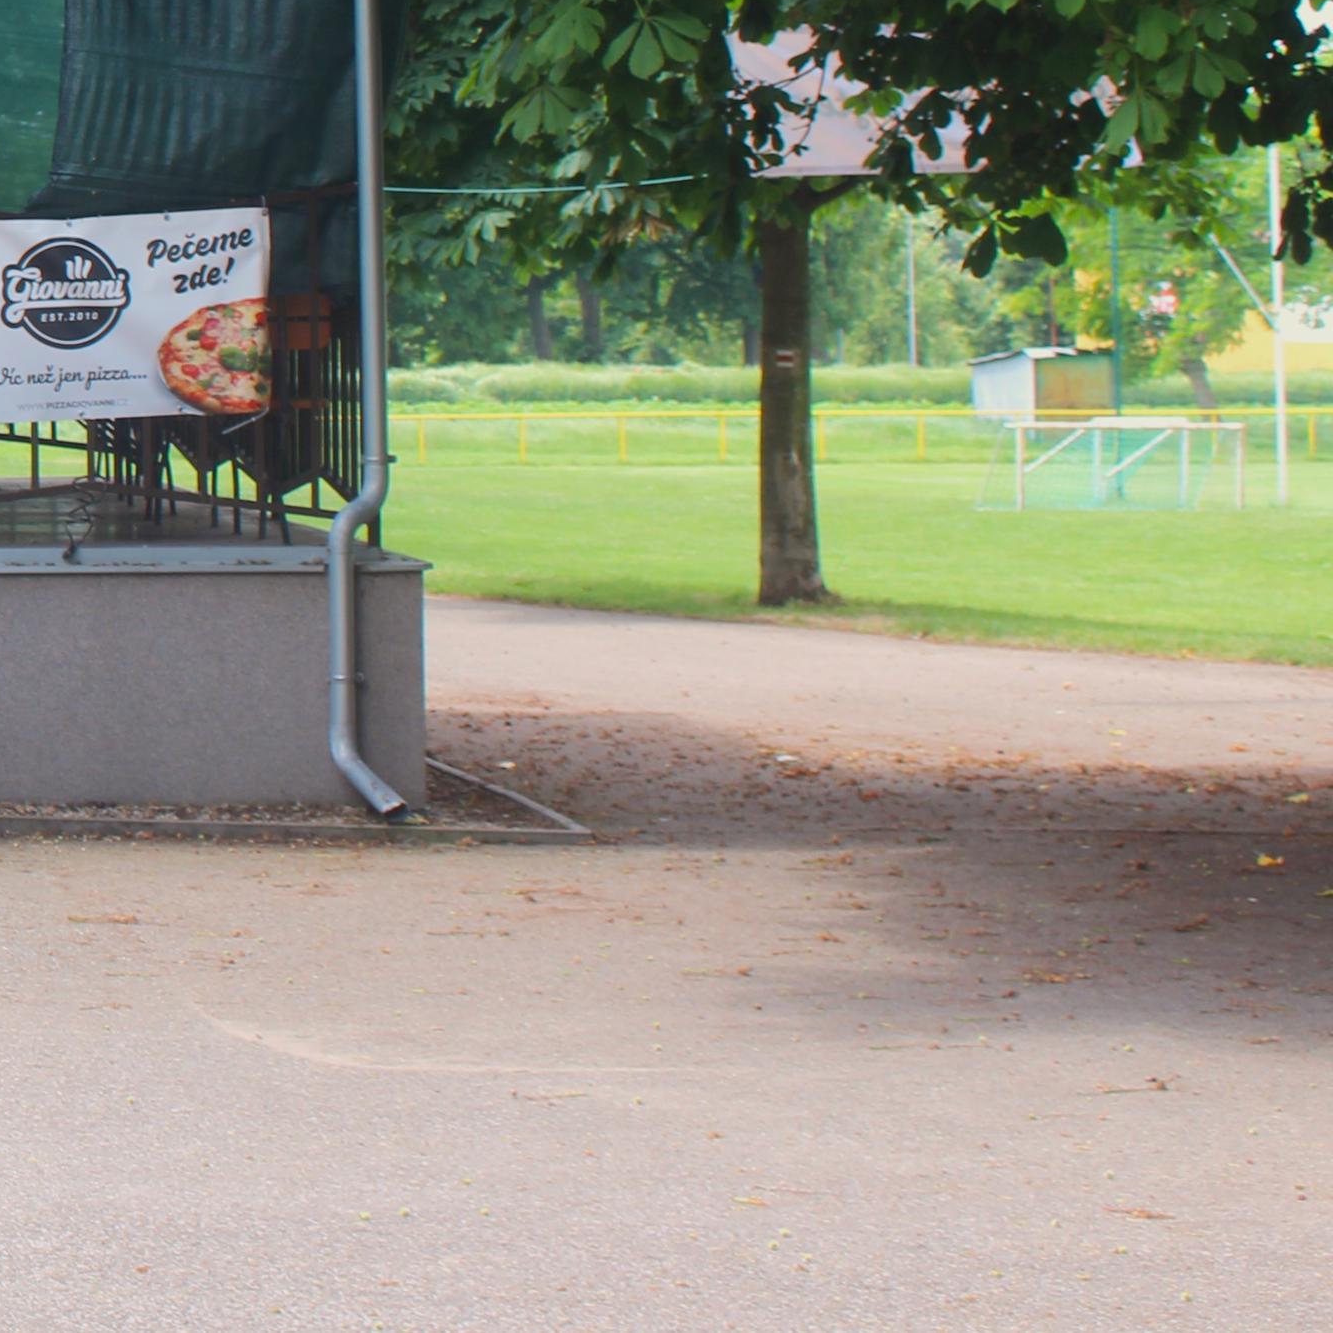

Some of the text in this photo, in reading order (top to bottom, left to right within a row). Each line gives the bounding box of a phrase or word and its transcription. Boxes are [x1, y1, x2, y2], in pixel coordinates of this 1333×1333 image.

[146, 228, 255, 268] Pečeme
[173, 257, 236, 294] zde!
[5, 267, 127, 323] Giovanni
[40, 311, 99, 323] EST.2010
[27, 365, 55, 384] než
[53, 368, 84, 392] jen
